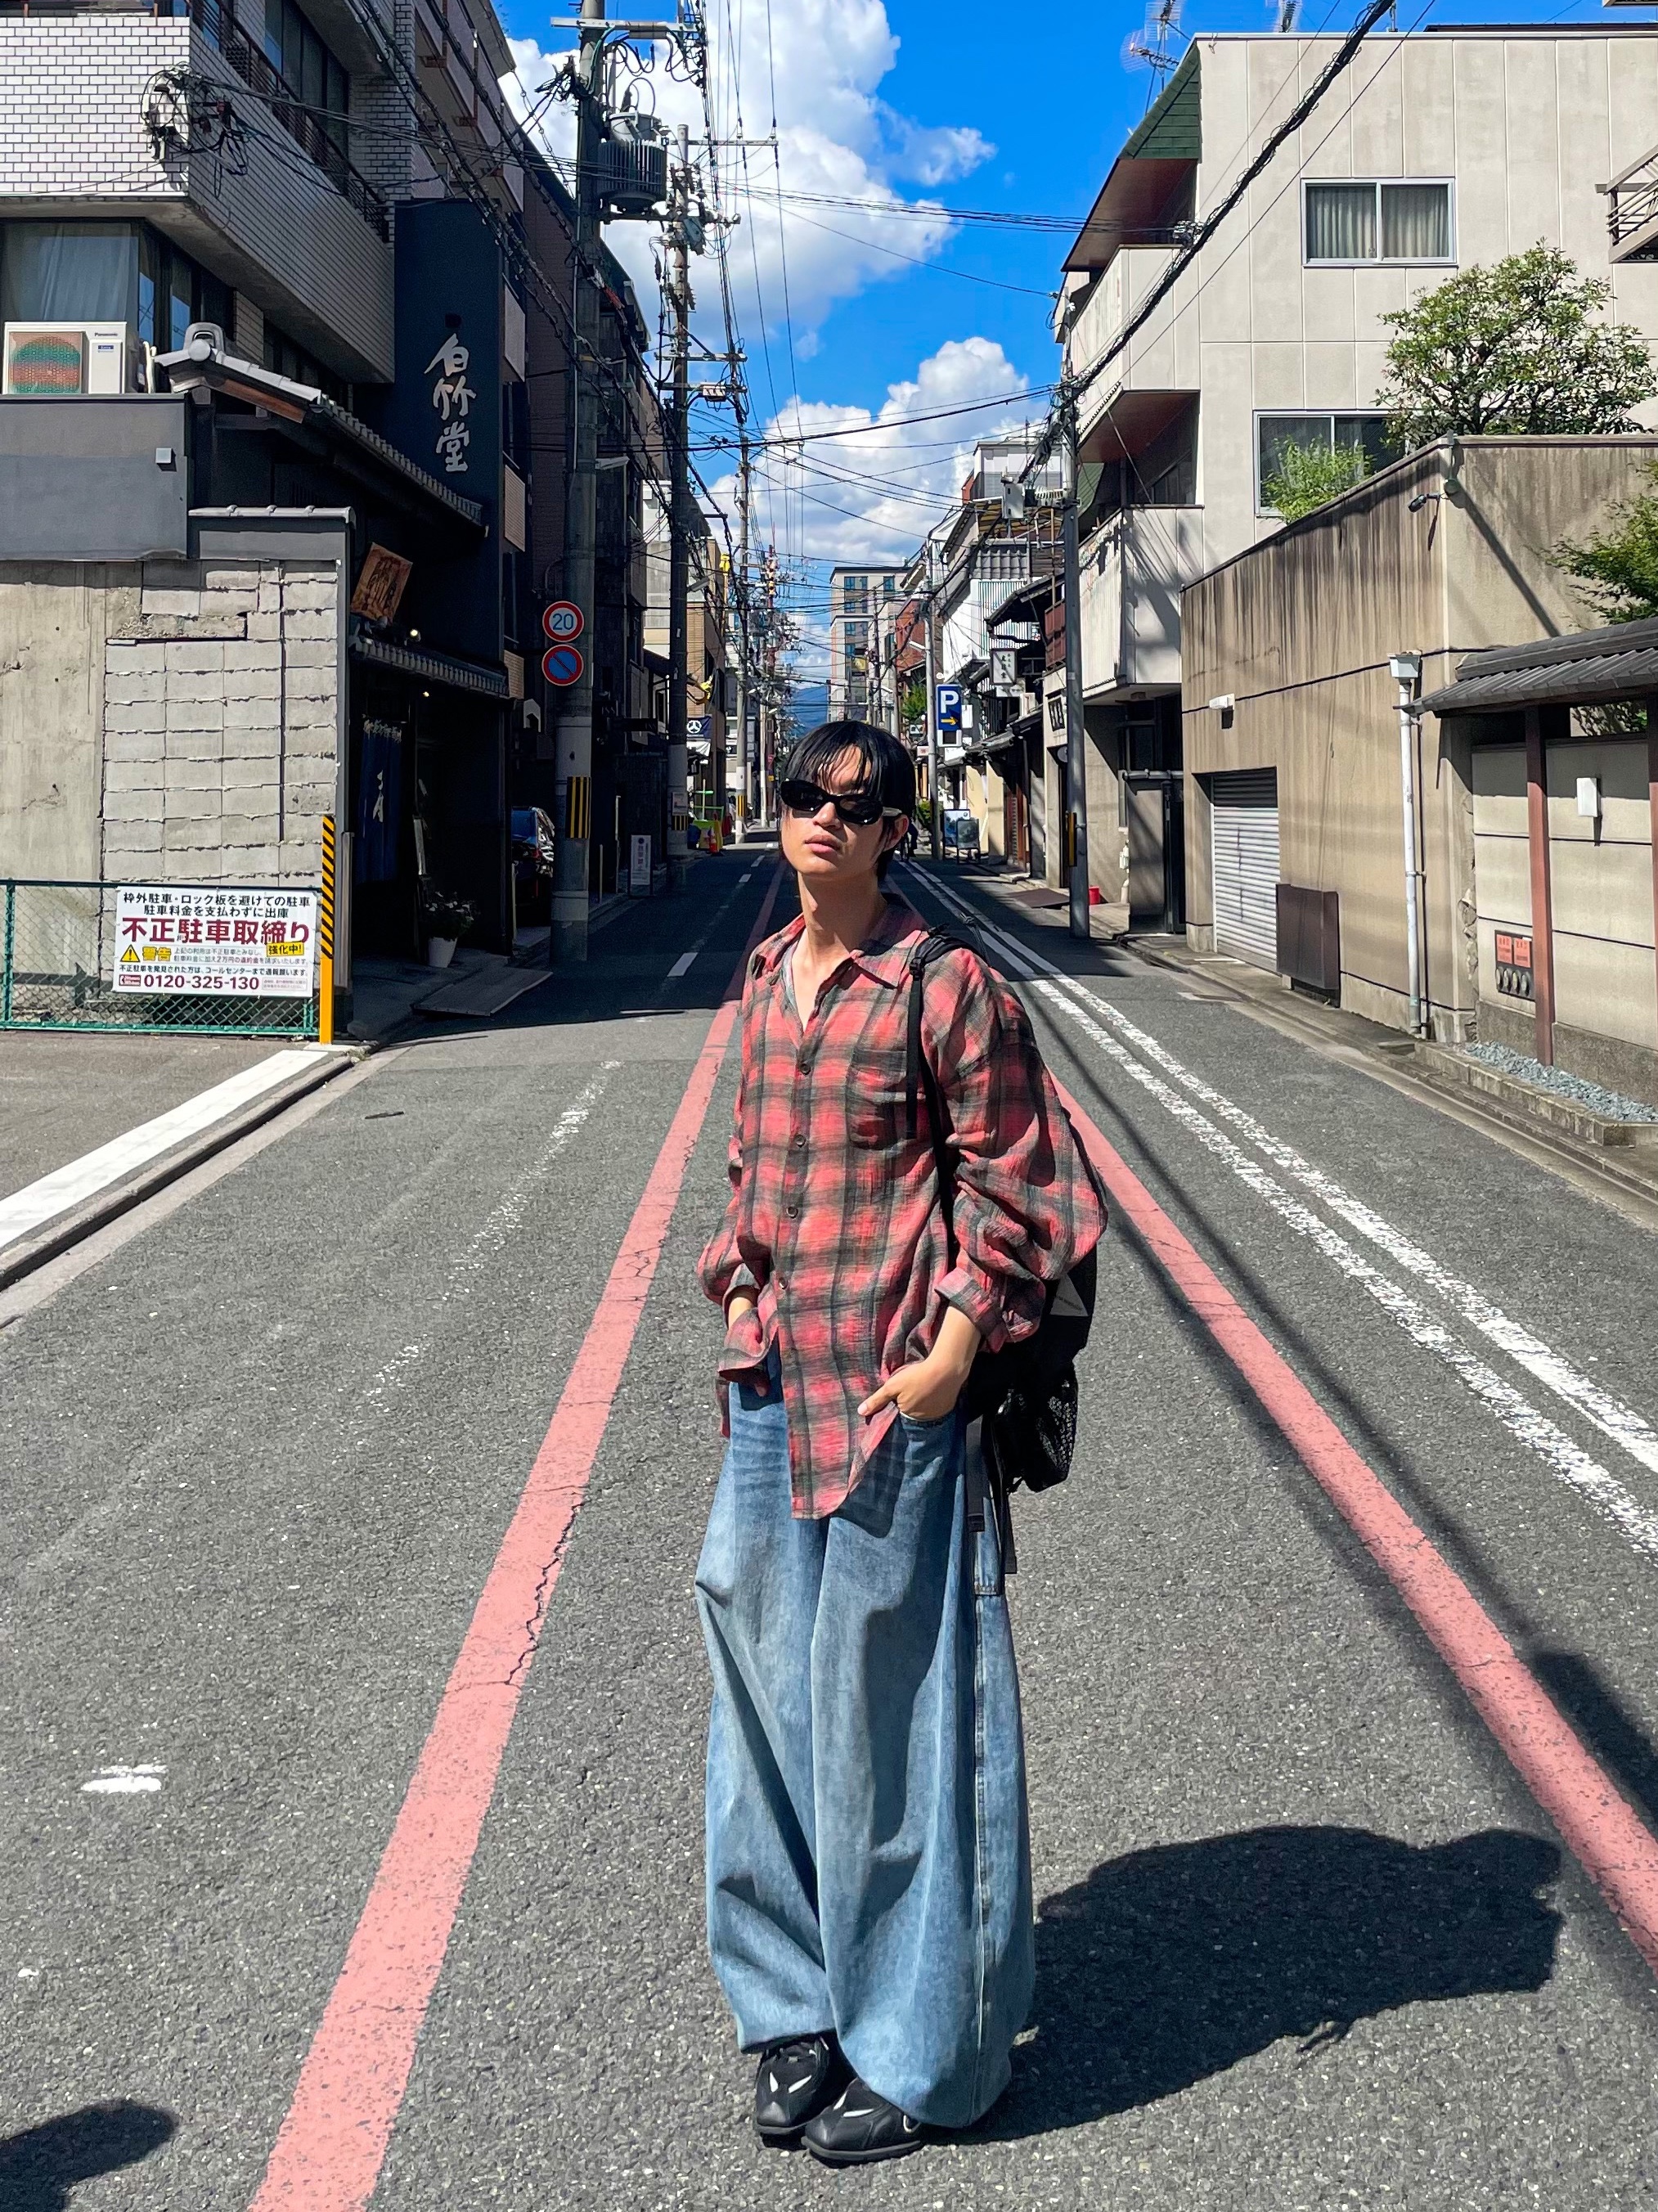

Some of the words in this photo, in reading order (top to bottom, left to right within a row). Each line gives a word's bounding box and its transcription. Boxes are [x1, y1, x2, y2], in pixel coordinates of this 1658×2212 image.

[424, 333, 477, 472] 白竹堂
[552, 613, 574, 630] 20
[940, 690, 959, 714] P
[124, 892, 310, 907] 枠外駐車・ロック板を避けての駐車
[144, 904, 289, 918] 駐車料金を支払わずに出庫
[122, 917, 309, 945] 不正駐車取締り
[144, 974, 259, 991] 0120-325-130
